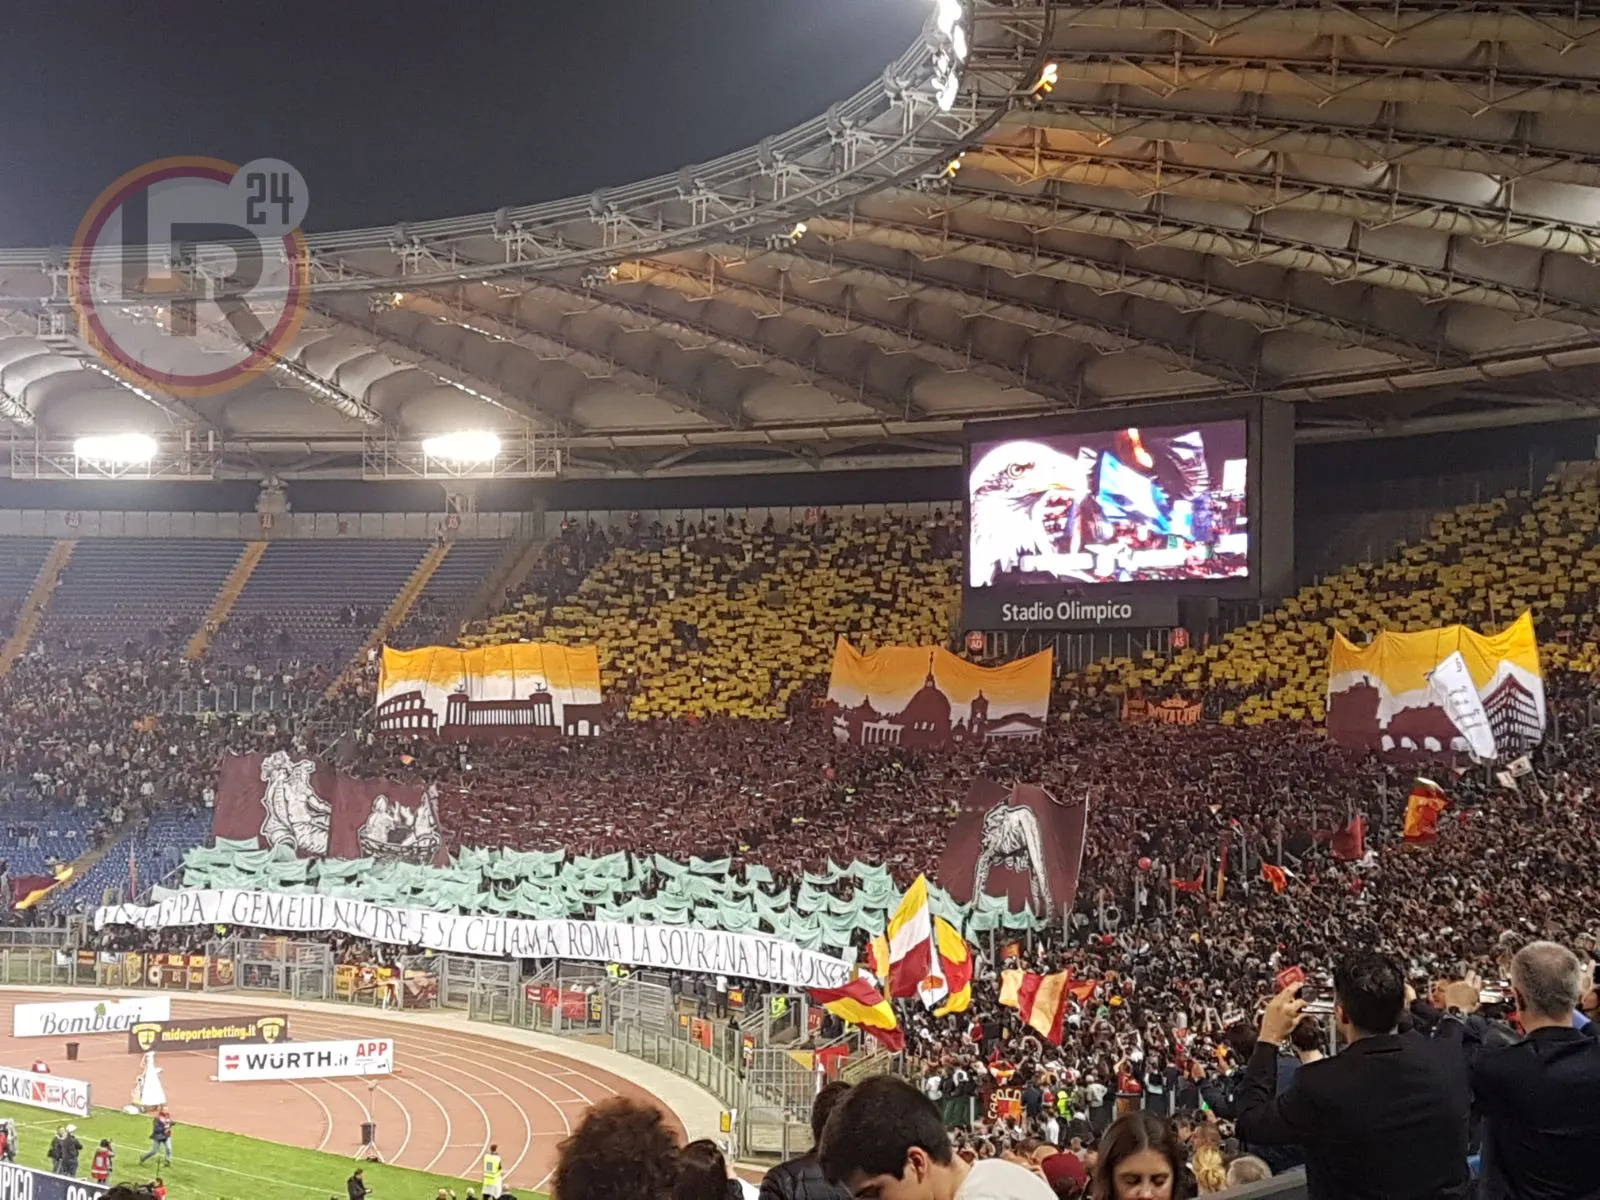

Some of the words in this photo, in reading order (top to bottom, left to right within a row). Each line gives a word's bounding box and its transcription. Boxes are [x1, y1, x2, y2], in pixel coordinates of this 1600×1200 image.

[1002, 602, 1054, 621] Stadio
[1056, 600, 1132, 623] Olimpico
[231, 891, 325, 929] GEMELLI
[436, 915, 454, 948] SI
[465, 917, 560, 956] CHIAMA
[567, 921, 622, 960] ROMA
[631, 925, 652, 962] LA
[660, 928, 751, 975] SOVRANA
[755, 939, 788, 982] DEL
[40, 1006, 142, 1034] Bombieri
[356, 1042, 388, 1057] APP
[0, 1164, 34, 1200] PICO
